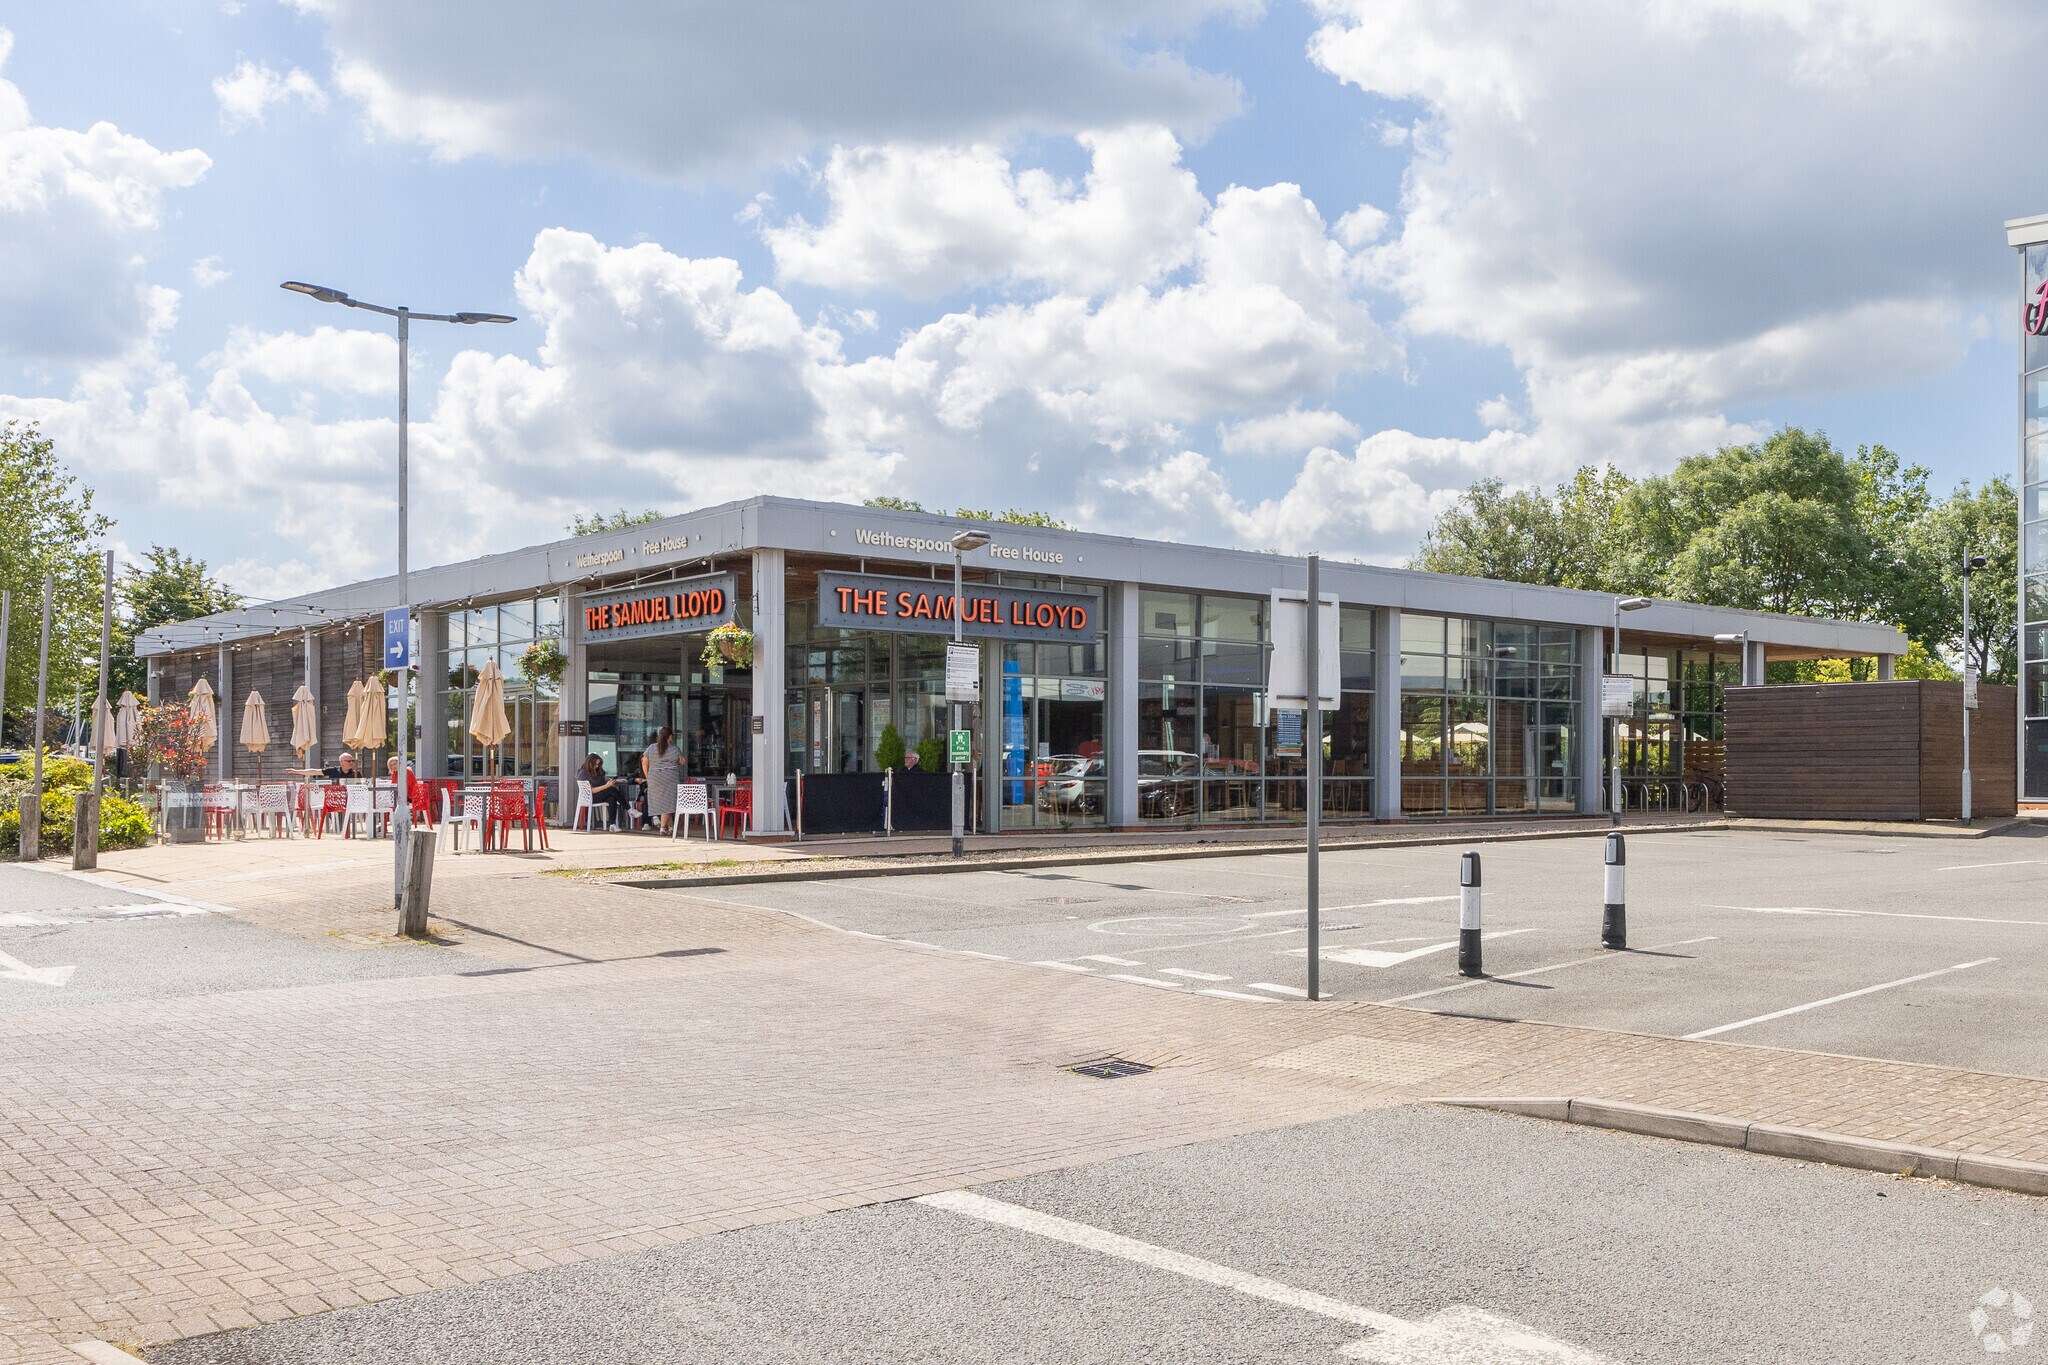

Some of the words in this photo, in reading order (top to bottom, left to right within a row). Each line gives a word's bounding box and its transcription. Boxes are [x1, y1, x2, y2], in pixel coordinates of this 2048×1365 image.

[643, 537, 660, 555] Free
[661, 535, 688, 551] House
[855, 528, 952, 553] Wetherspoon
[576, 549, 624, 568] Wetherspoon
[990, 543, 1018, 560] Free
[1022, 546, 1064, 564] House
[585, 606, 610, 631] THE
[612, 596, 670, 627] SAMUEL
[674, 588, 725, 620] LLOYD
[836, 587, 888, 616] THE
[897, 592, 1004, 624] SAMUEL
[1012, 601, 1087, 630] LLOYD
[389, 619, 405, 634] EXIT
